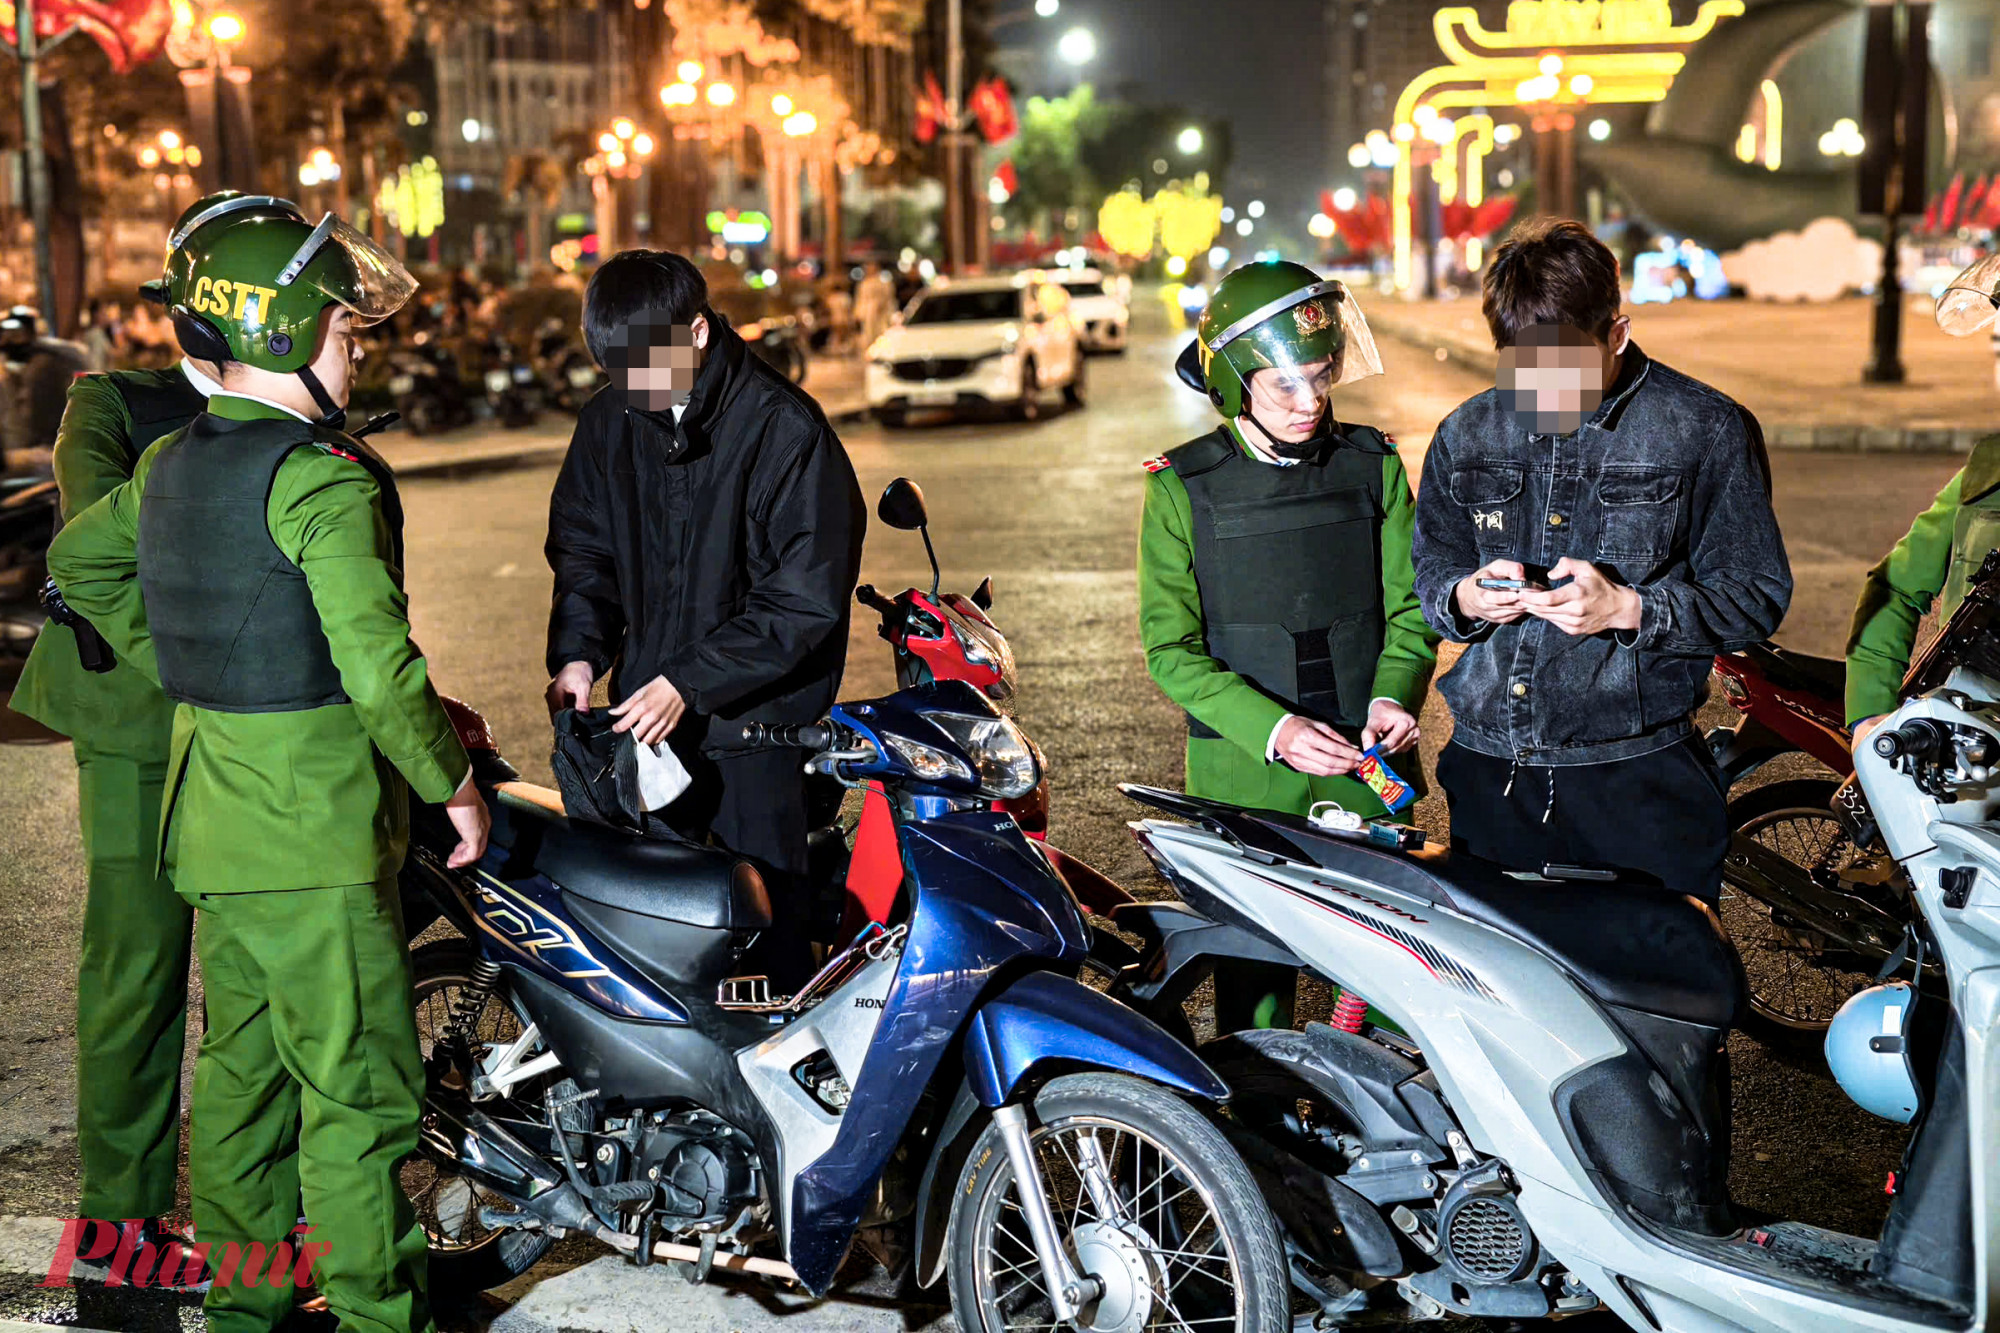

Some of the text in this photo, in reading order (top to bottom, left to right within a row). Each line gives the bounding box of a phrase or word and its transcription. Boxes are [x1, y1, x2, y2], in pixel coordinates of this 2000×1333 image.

[194, 276, 277, 325] CSTT
[1836, 785, 1866, 828] 332
[1311, 879, 1429, 924] VISION
